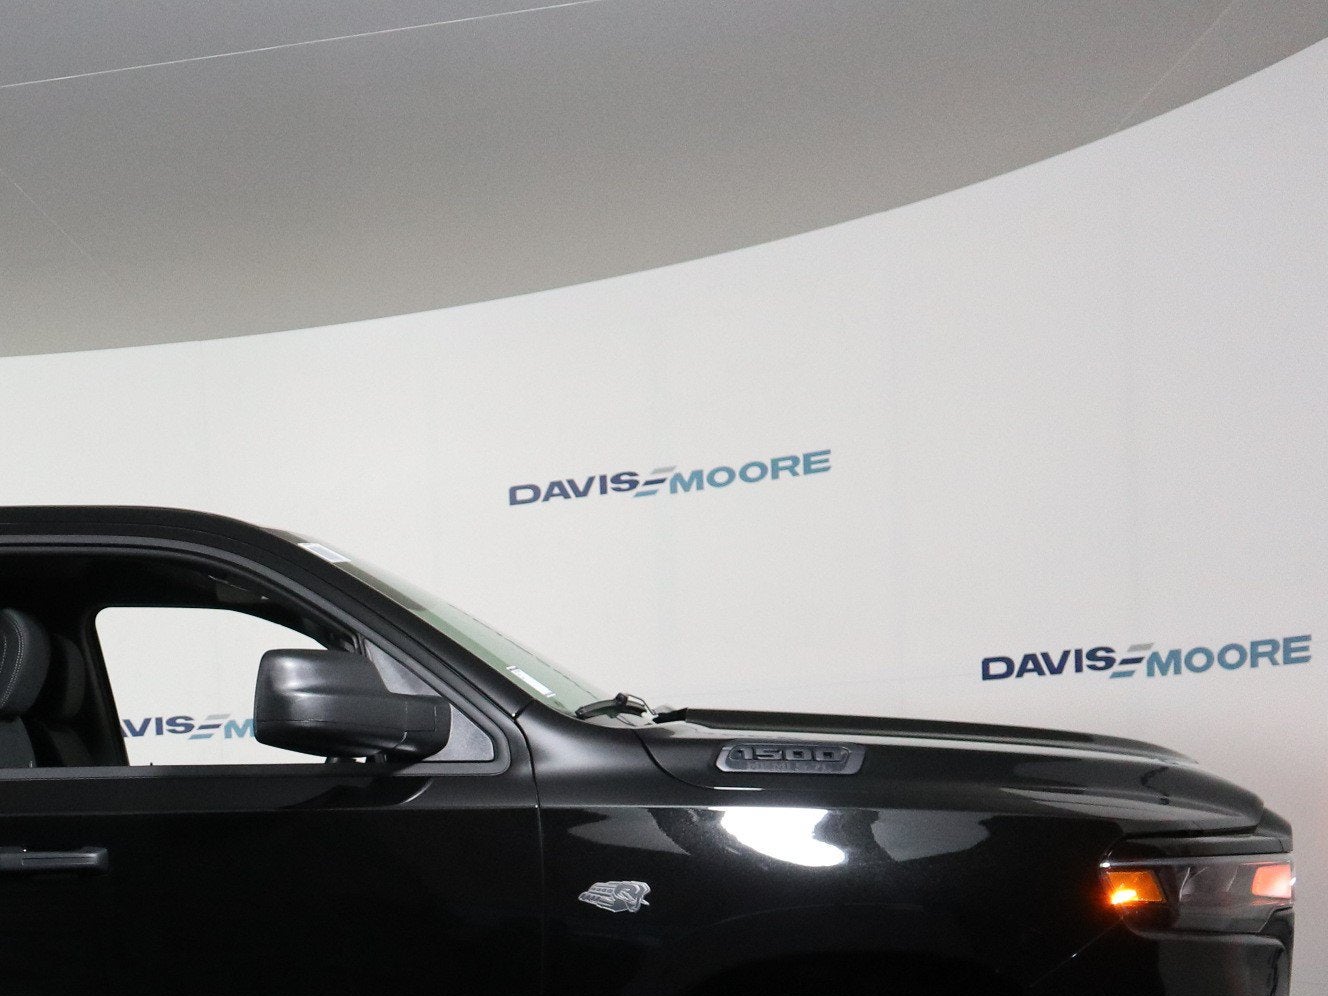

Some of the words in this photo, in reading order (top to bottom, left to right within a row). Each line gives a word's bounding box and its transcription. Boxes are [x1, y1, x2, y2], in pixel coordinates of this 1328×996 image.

[509, 471, 640, 505] DAVIS
[670, 449, 831, 494] MOORE
[981, 646, 1116, 681] DAVIS
[1146, 634, 1312, 677] MOORE
[122, 715, 195, 738] VIS
[737, 746, 843, 763] 1500
